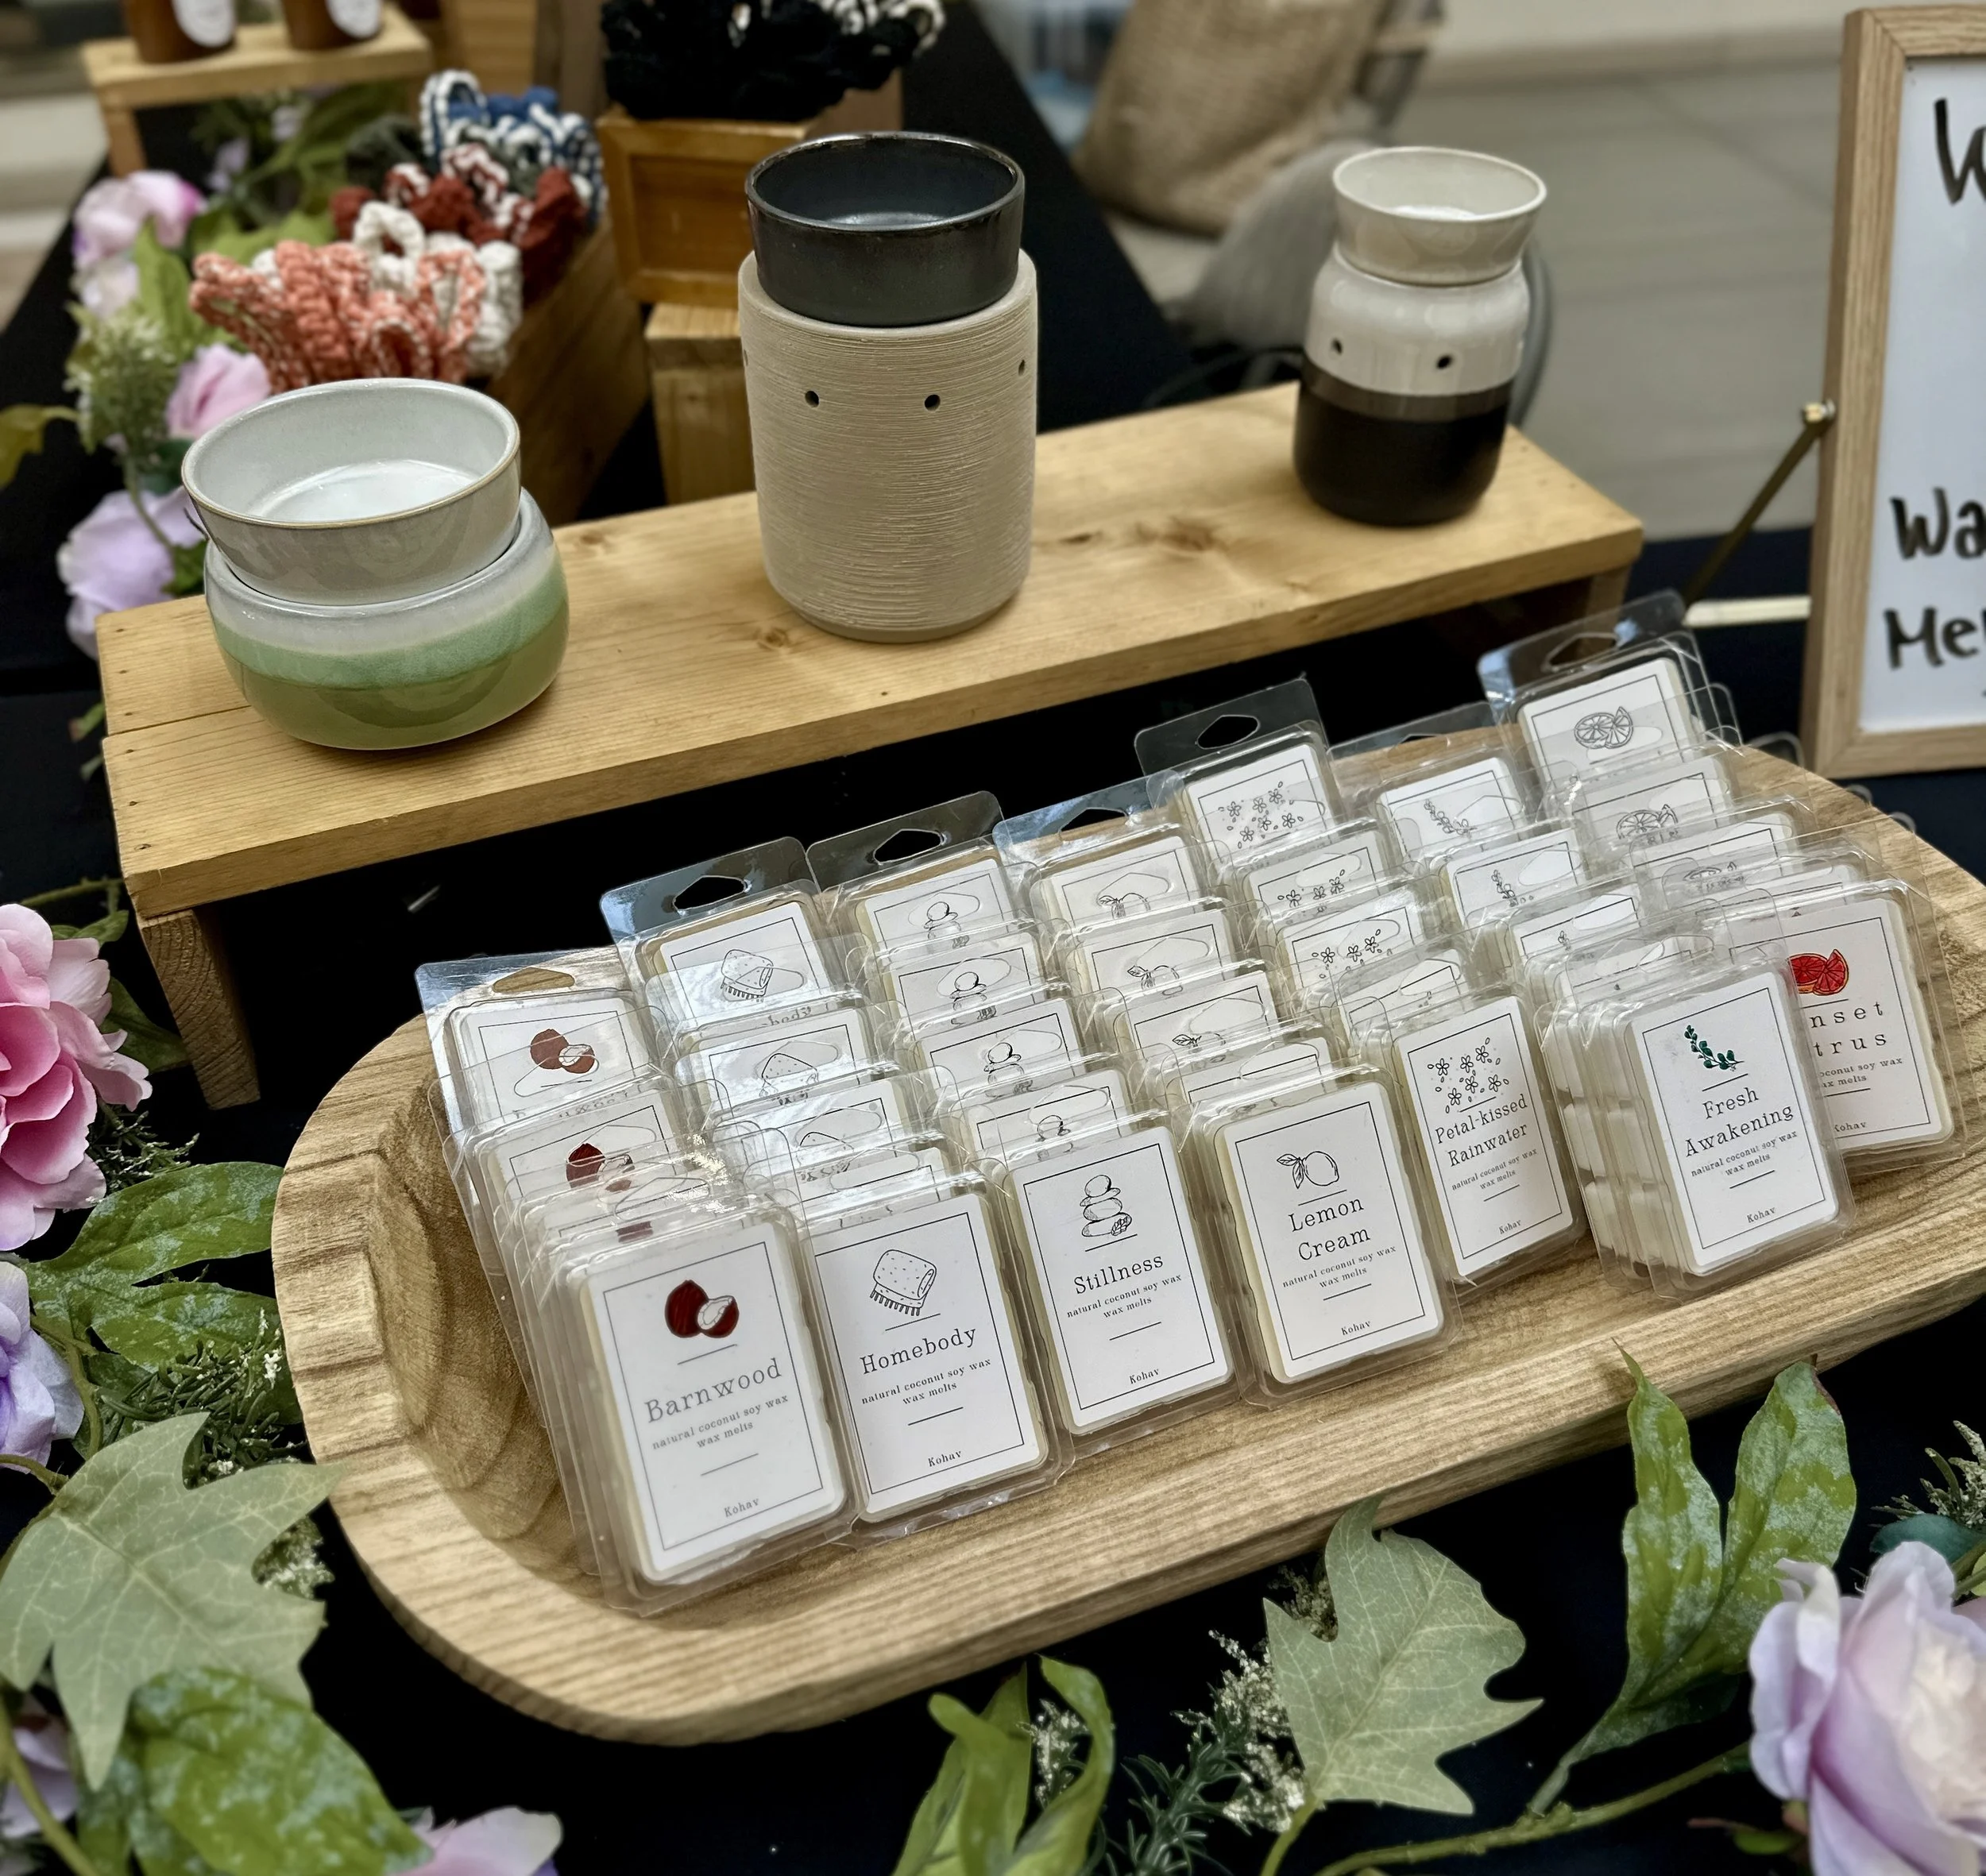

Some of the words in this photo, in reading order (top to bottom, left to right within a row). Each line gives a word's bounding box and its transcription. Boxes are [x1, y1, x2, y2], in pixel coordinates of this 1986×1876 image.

[1809, 1001, 1884, 1029] nset
[1813, 1033, 1887, 1057] trus
[1857, 1061, 1876, 1071] soy
[1880, 1057, 1903, 1067] wax
[1838, 1075, 1867, 1086] melts
[1702, 1087, 1760, 1120] Fresh
[1435, 1093, 1528, 1144] Petal-kissed
[1685, 1106, 1795, 1158] Awakening
[1447, 1124, 1528, 1168] Rainwater
[1690, 1158, 1724, 1177] natural
[1725, 1145, 1760, 1164] coconut
[1761, 1137, 1777, 1149] soy
[1779, 1130, 1798, 1142] wax
[1451, 1172, 1478, 1191] natural
[1480, 1161, 1507, 1178] coconut
[1509, 1155, 1520, 1165] soy
[1522, 1148, 1538, 1160] wax
[1725, 1164, 1745, 1176] wax
[1747, 1153, 1772, 1168] melts
[1480, 1179, 1496, 1190] wax
[1497, 1169, 1517, 1183] melts
[1288, 1199, 1365, 1233] Lemon
[1498, 1218, 1522, 1236] Kohav
[1746, 1206, 1776, 1226] Kohav
[1298, 1229, 1371, 1261] Cream
[1073, 1256, 1164, 1295] Stillness
[1282, 1269, 1318, 1288] natural
[1320, 1258, 1355, 1276] coconut
[1358, 1253, 1374, 1263] soy
[1377, 1245, 1397, 1257] wax
[1319, 1276, 1340, 1288] wax
[1342, 1267, 1368, 1281] melts
[1067, 1299, 1102, 1318] natural
[1104, 1287, 1140, 1305] coconut
[1143, 1281, 1158, 1292] soy
[1161, 1274, 1183, 1287] wax
[1103, 1307, 1123, 1318] wax
[1126, 1296, 1152, 1311] melts
[1341, 1319, 1372, 1337] Kohav
[860, 1328, 976, 1375] Homebody
[644, 1357, 782, 1423] Barnwood
[861, 1384, 901, 1405] natural
[904, 1372, 945, 1391] coconut
[948, 1366, 965, 1377] soy
[969, 1359, 991, 1371] wax
[1129, 1368, 1160, 1385] Kohav
[902, 1392, 925, 1405] wax
[929, 1382, 957, 1397] melts
[652, 1426, 695, 1449] natural
[698, 1411, 740, 1433] coconut
[744, 1404, 761, 1416] soy
[765, 1395, 789, 1408] wax
[696, 1434, 721, 1448] wax
[724, 1422, 754, 1438] melts
[927, 1450, 962, 1469] Kohav
[724, 1498, 759, 1518] Kohav
